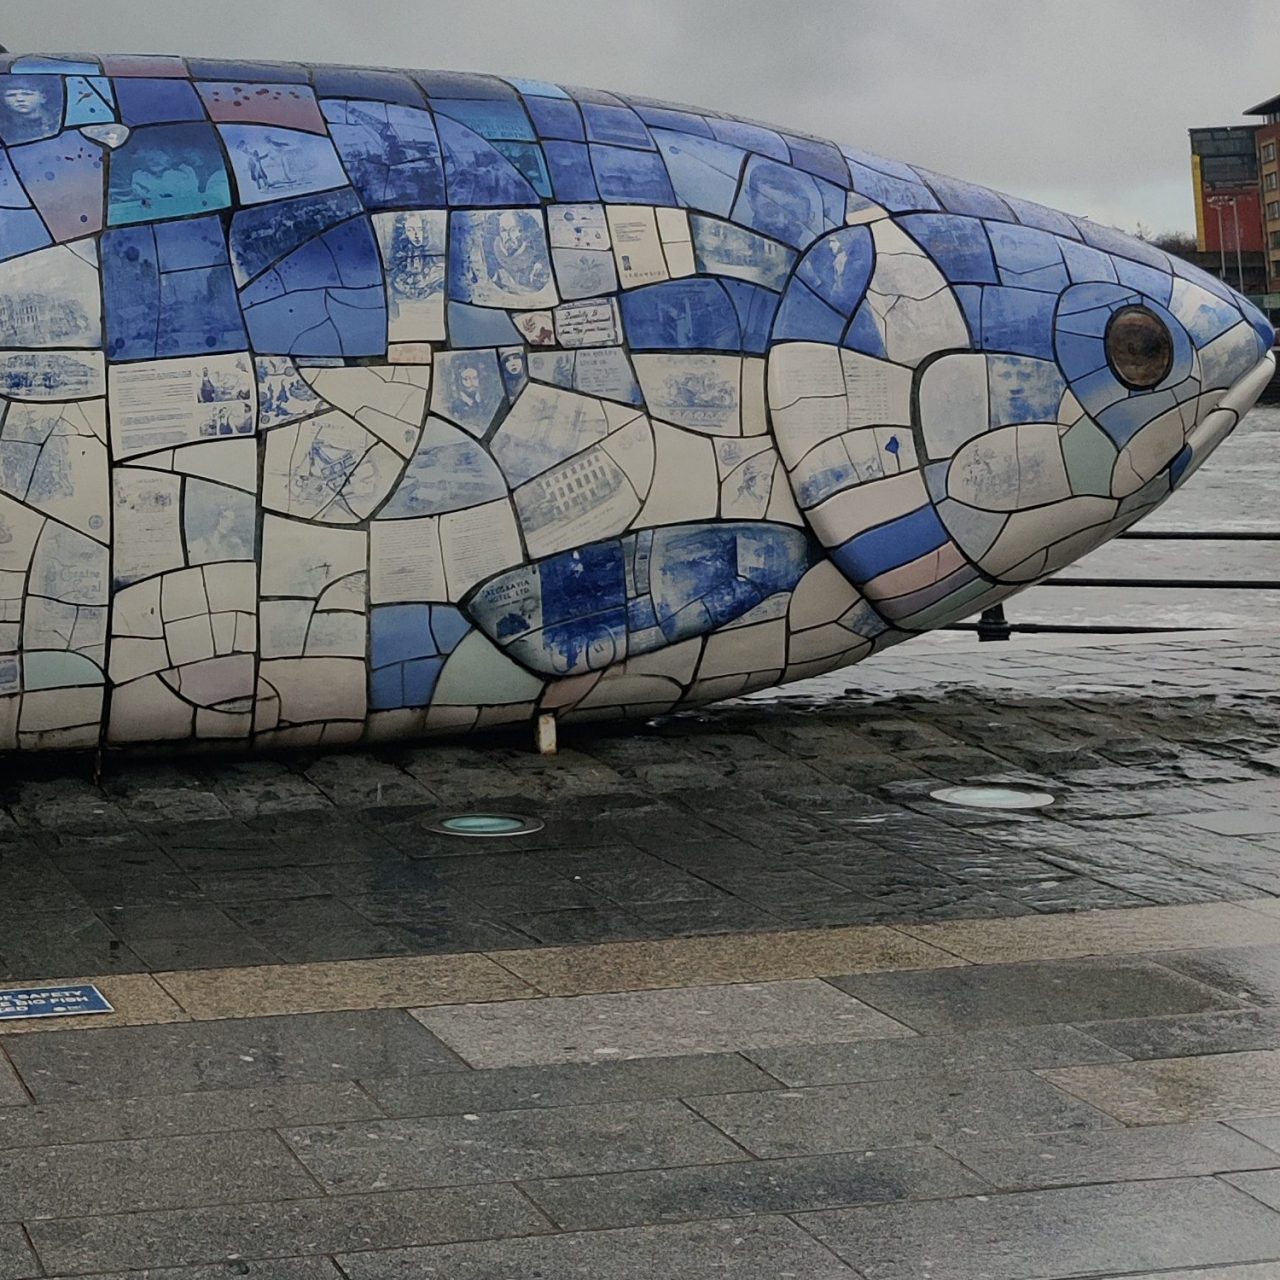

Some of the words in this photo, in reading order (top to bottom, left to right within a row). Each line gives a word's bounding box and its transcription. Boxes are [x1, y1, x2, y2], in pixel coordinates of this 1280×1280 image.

[17, 990, 82, 999] SAFETY
[15, 998, 46, 1006] BIG
[50, 996, 89, 1004] FISH
